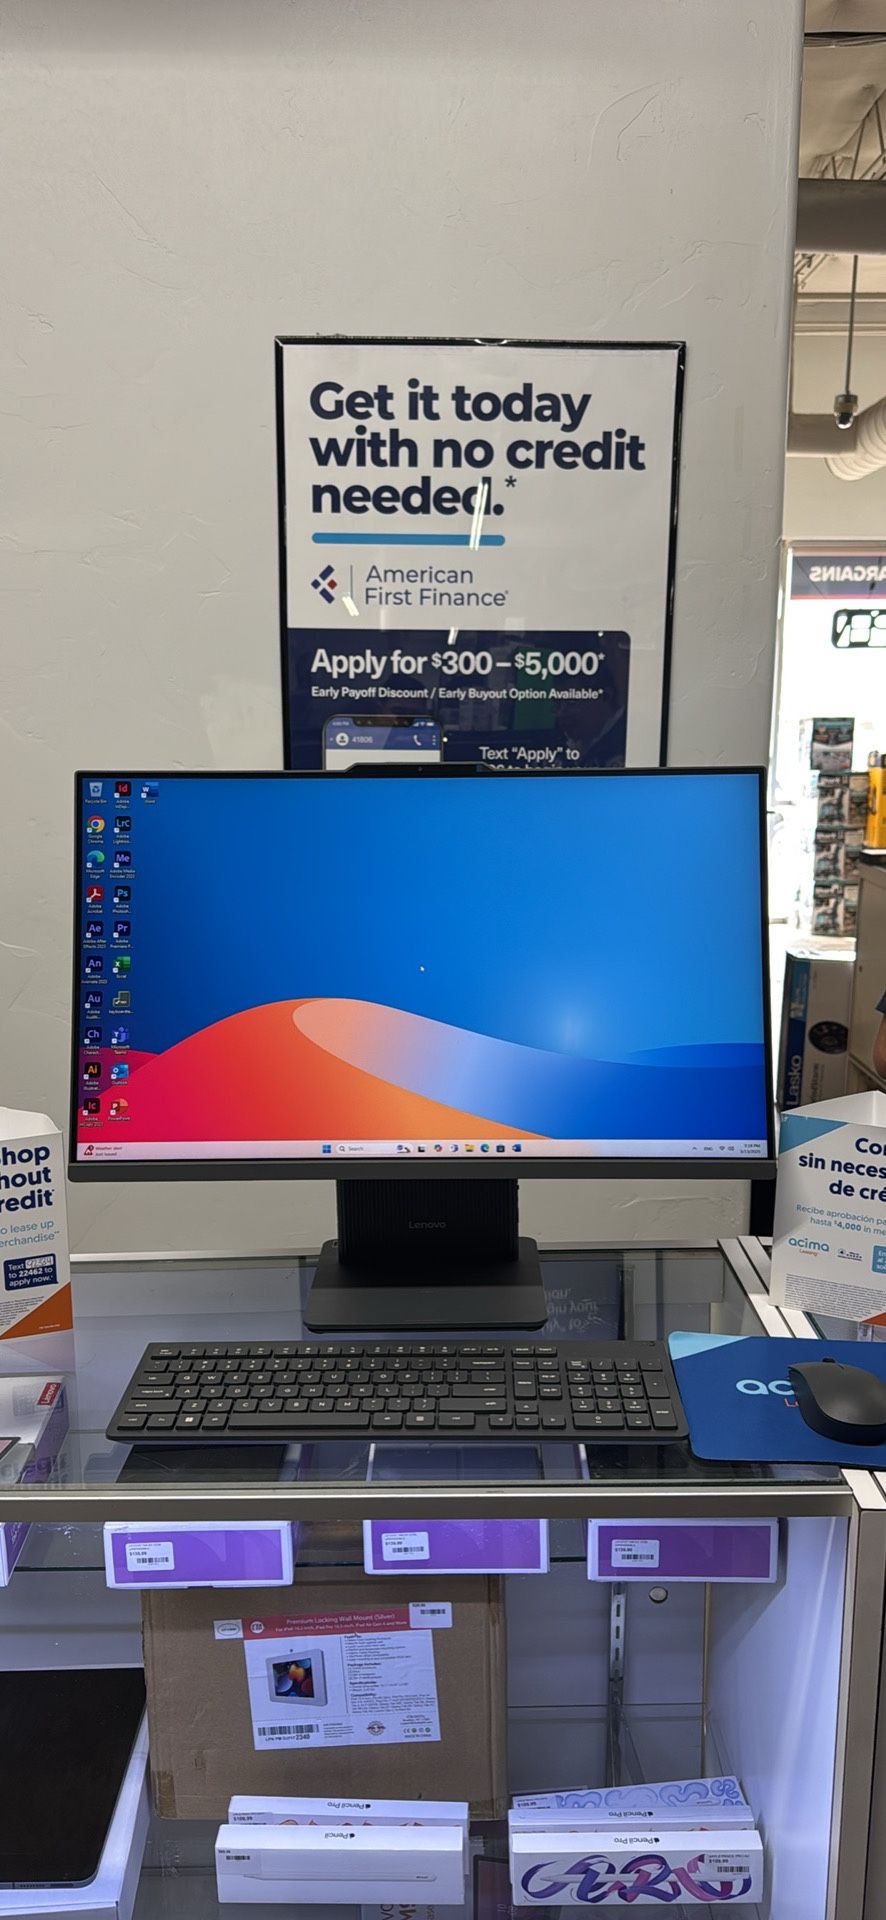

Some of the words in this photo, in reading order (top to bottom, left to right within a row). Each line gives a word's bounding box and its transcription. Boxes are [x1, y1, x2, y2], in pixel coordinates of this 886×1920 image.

[309, 380, 395, 421] Get
[407, 378, 441, 421] it
[452, 382, 592, 433] today
[309, 424, 418, 468] with
[432, 438, 495, 468] no
[505, 428, 646, 471] credit
[366, 565, 473, 584] American
[365, 587, 412, 606] First
[310, 648, 388, 680] Apply
[390, 649, 428, 674] for
[431, 650, 493, 675] $300
[311, 686, 340, 700] Early
[341, 686, 377, 700] Payoff
[378, 687, 429, 699] Discount
[438, 688, 467, 700] Early
[468, 688, 508, 700] Buyout
[509, 688, 548, 700] Option
[478, 746, 508, 760] Text
[566, 747, 580, 760] to
[118, 784, 128, 792] Id
[116, 854, 130, 862] Me
[88, 1030, 99, 1038] Ch
[88, 1065, 97, 1073] Ai
[786, 1055, 801, 1105] Lasko
[0, 1146, 50, 1166] hop
[798, 1152, 826, 1170] sin
[829, 1180, 855, 1197] de
[796, 1204, 824, 1216] Recibe
[827, 1210, 874, 1224] aprobación
[10, 1223, 38, 1233] lease
[40, 1221, 54, 1230] up
[409, 1220, 446, 1229] Lenovo
[810, 1216, 832, 1227] hasta
[834, 1220, 862, 1232] $4,000
[863, 1225, 871, 1233] in
[788, 1237, 830, 1252] acima
[8, 1262, 24, 1271] Text
[19, 1269, 43, 1277] 22462
[9, 1278, 31, 1287] apply
